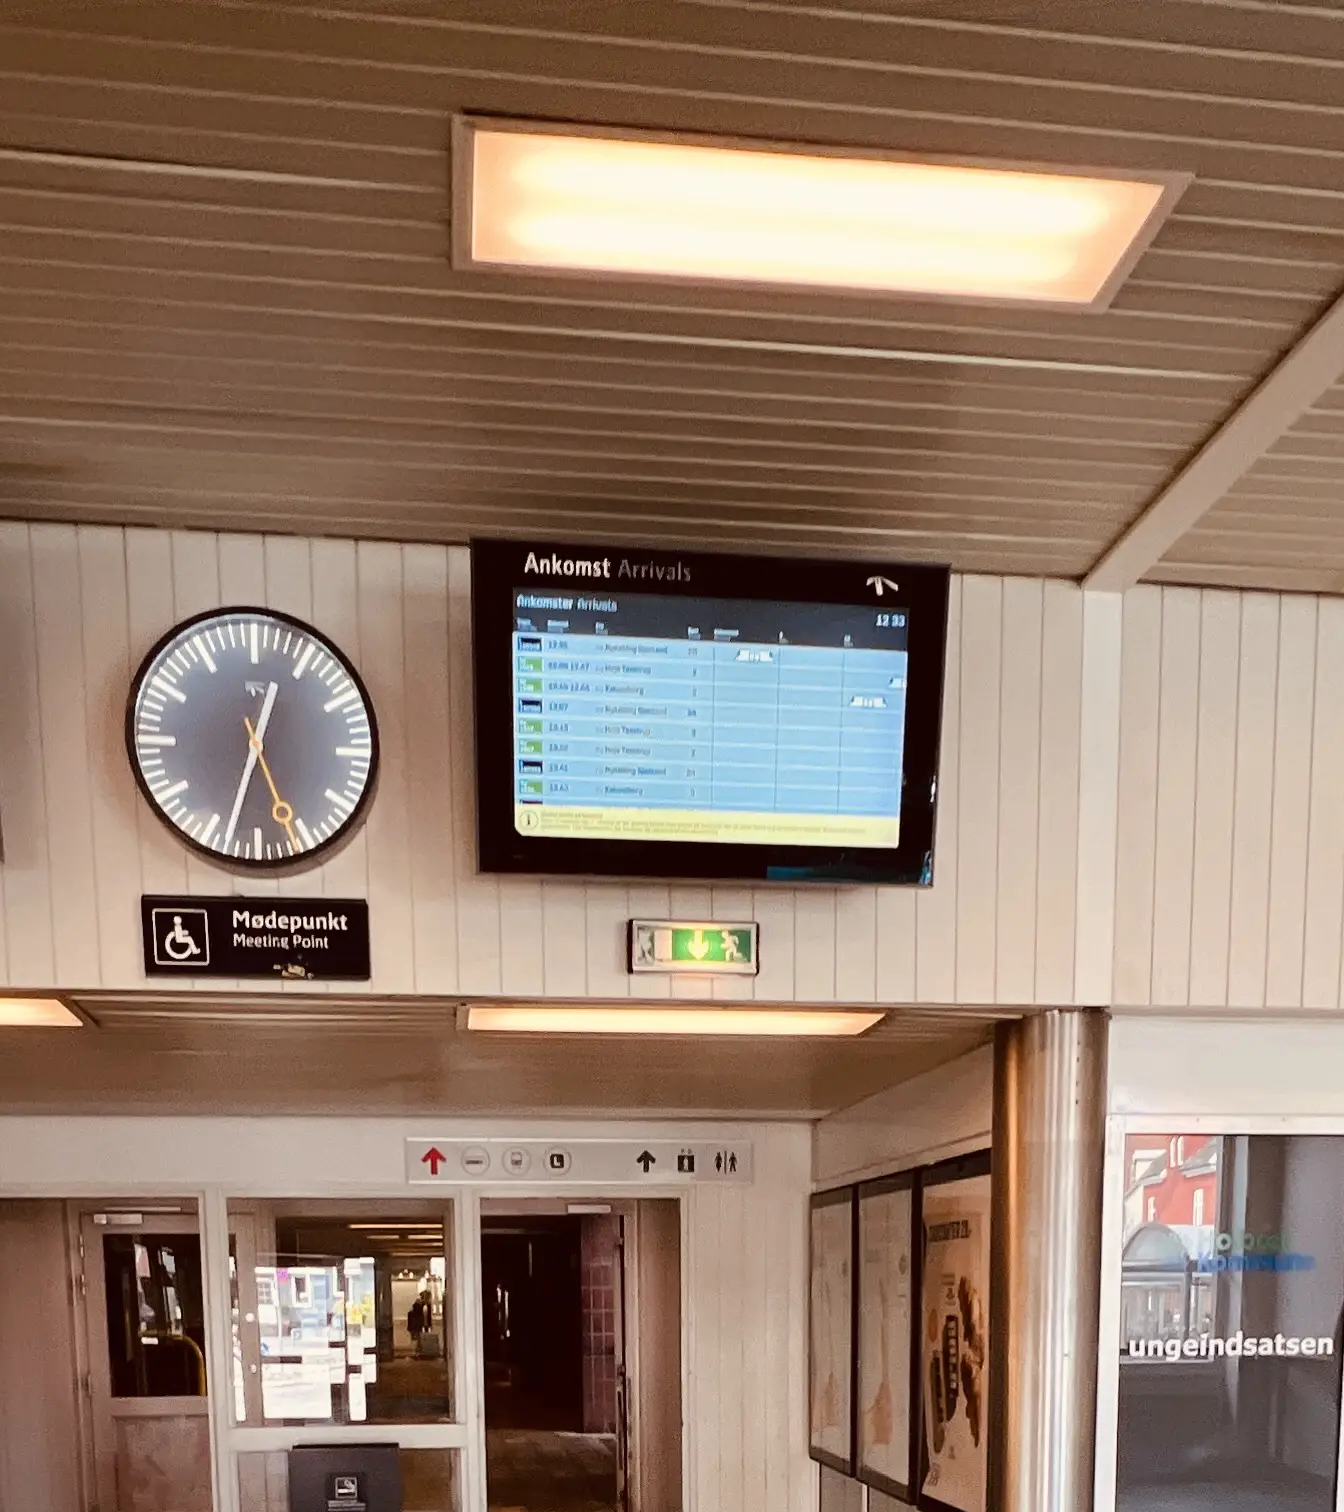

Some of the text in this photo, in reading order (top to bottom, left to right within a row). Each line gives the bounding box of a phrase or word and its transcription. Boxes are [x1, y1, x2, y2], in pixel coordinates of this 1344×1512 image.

[523, 551, 692, 583] Ankomst Arrivals
[232, 909, 349, 934] Mødepunkt
[232, 932, 329, 950] Meeting Point
[1128, 1329, 1335, 1362] ungeindsatsen
